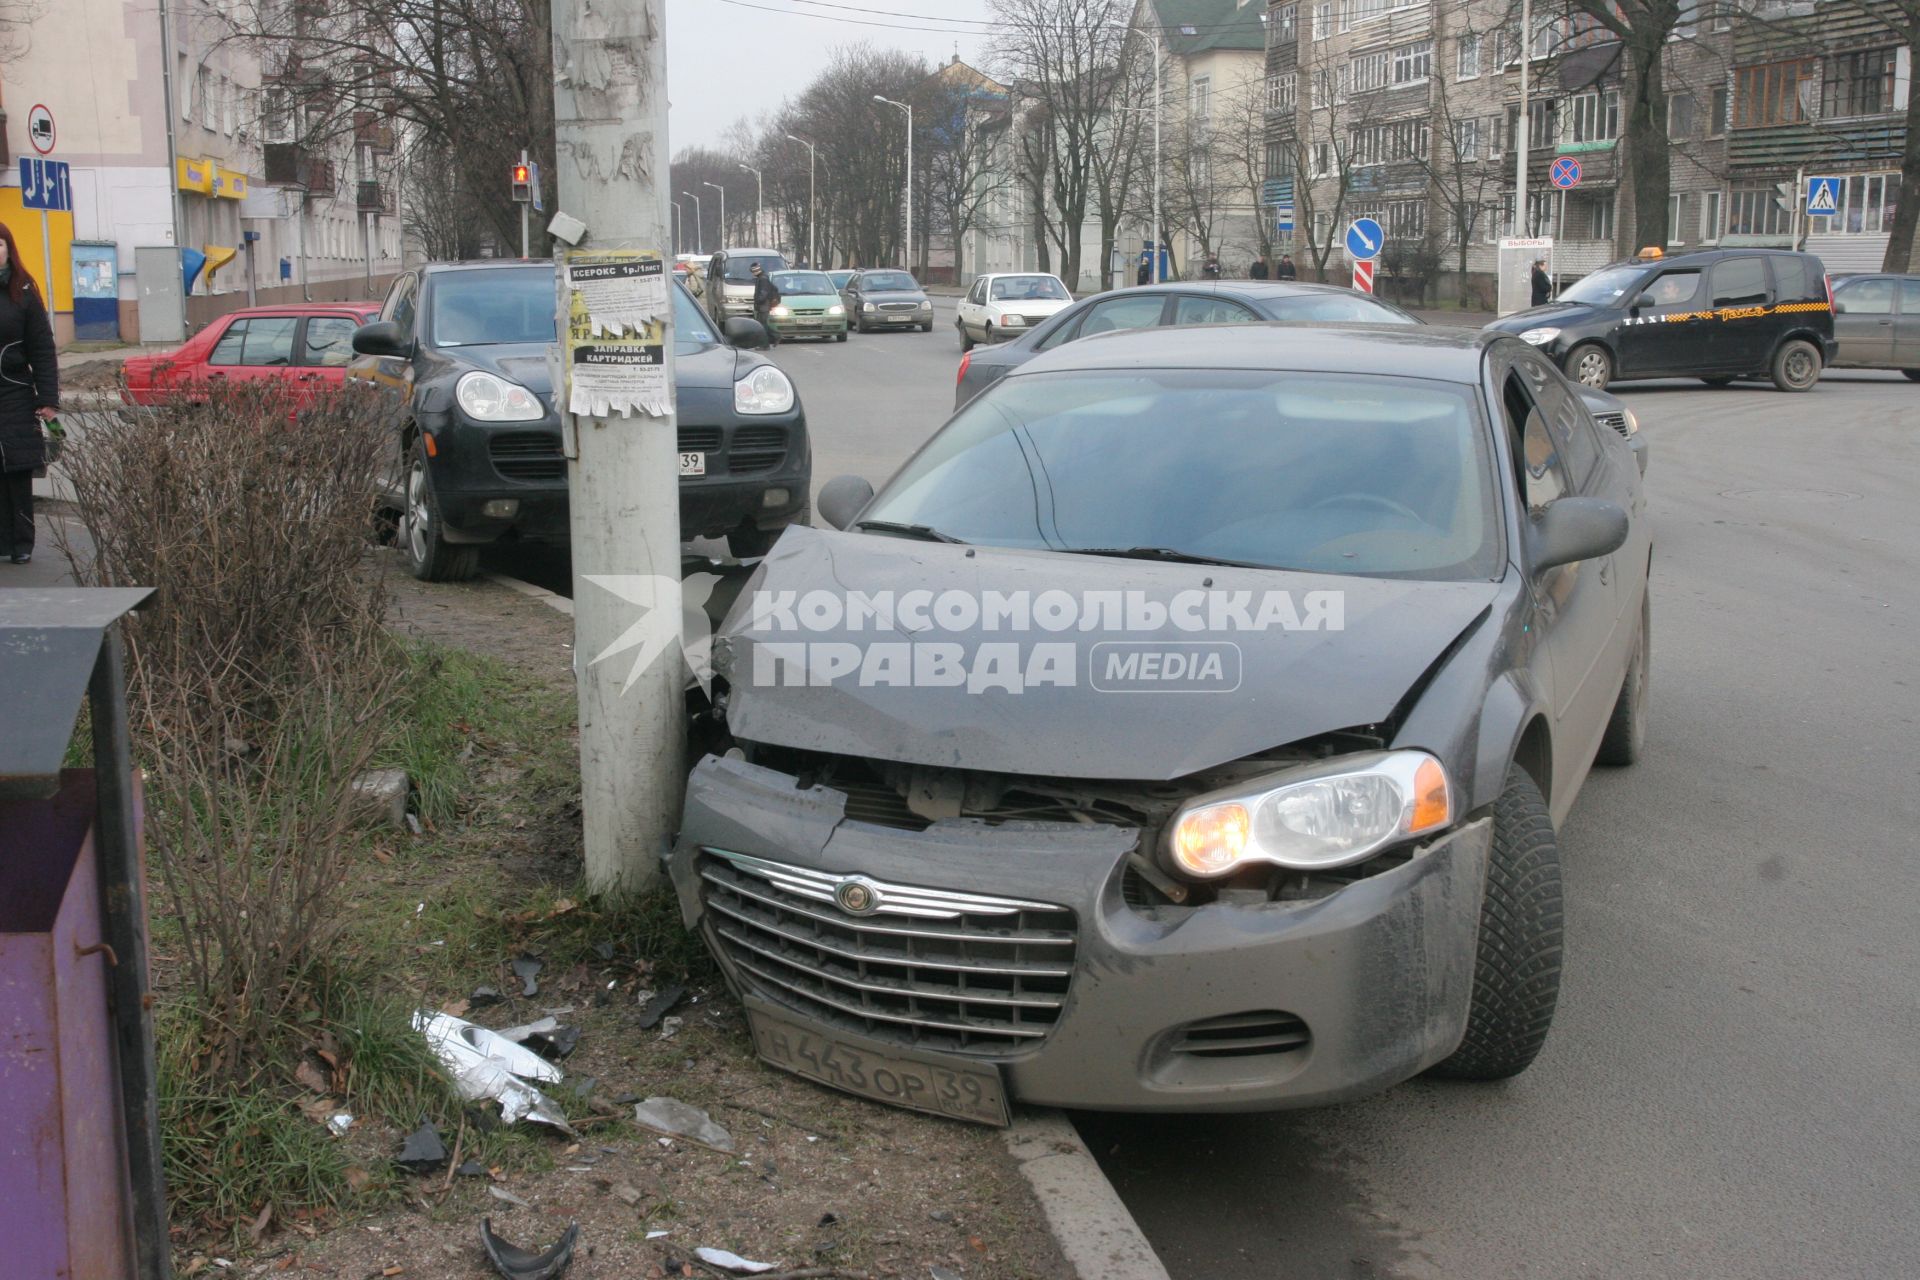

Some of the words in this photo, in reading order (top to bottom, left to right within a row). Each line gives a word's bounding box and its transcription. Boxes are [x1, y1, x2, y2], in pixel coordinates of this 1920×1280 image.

[1507, 239, 1545, 247] ВЫБОРЫ
[572, 267, 616, 278] КСЕРОКС
[1623, 314, 1667, 326] TAXI
[593, 345, 646, 353] ЗАПРАВКА
[586, 354, 653, 364] КАРТРИДЖЕЙ
[681, 453, 699, 468] 39
[938, 1070, 982, 1105] 39
